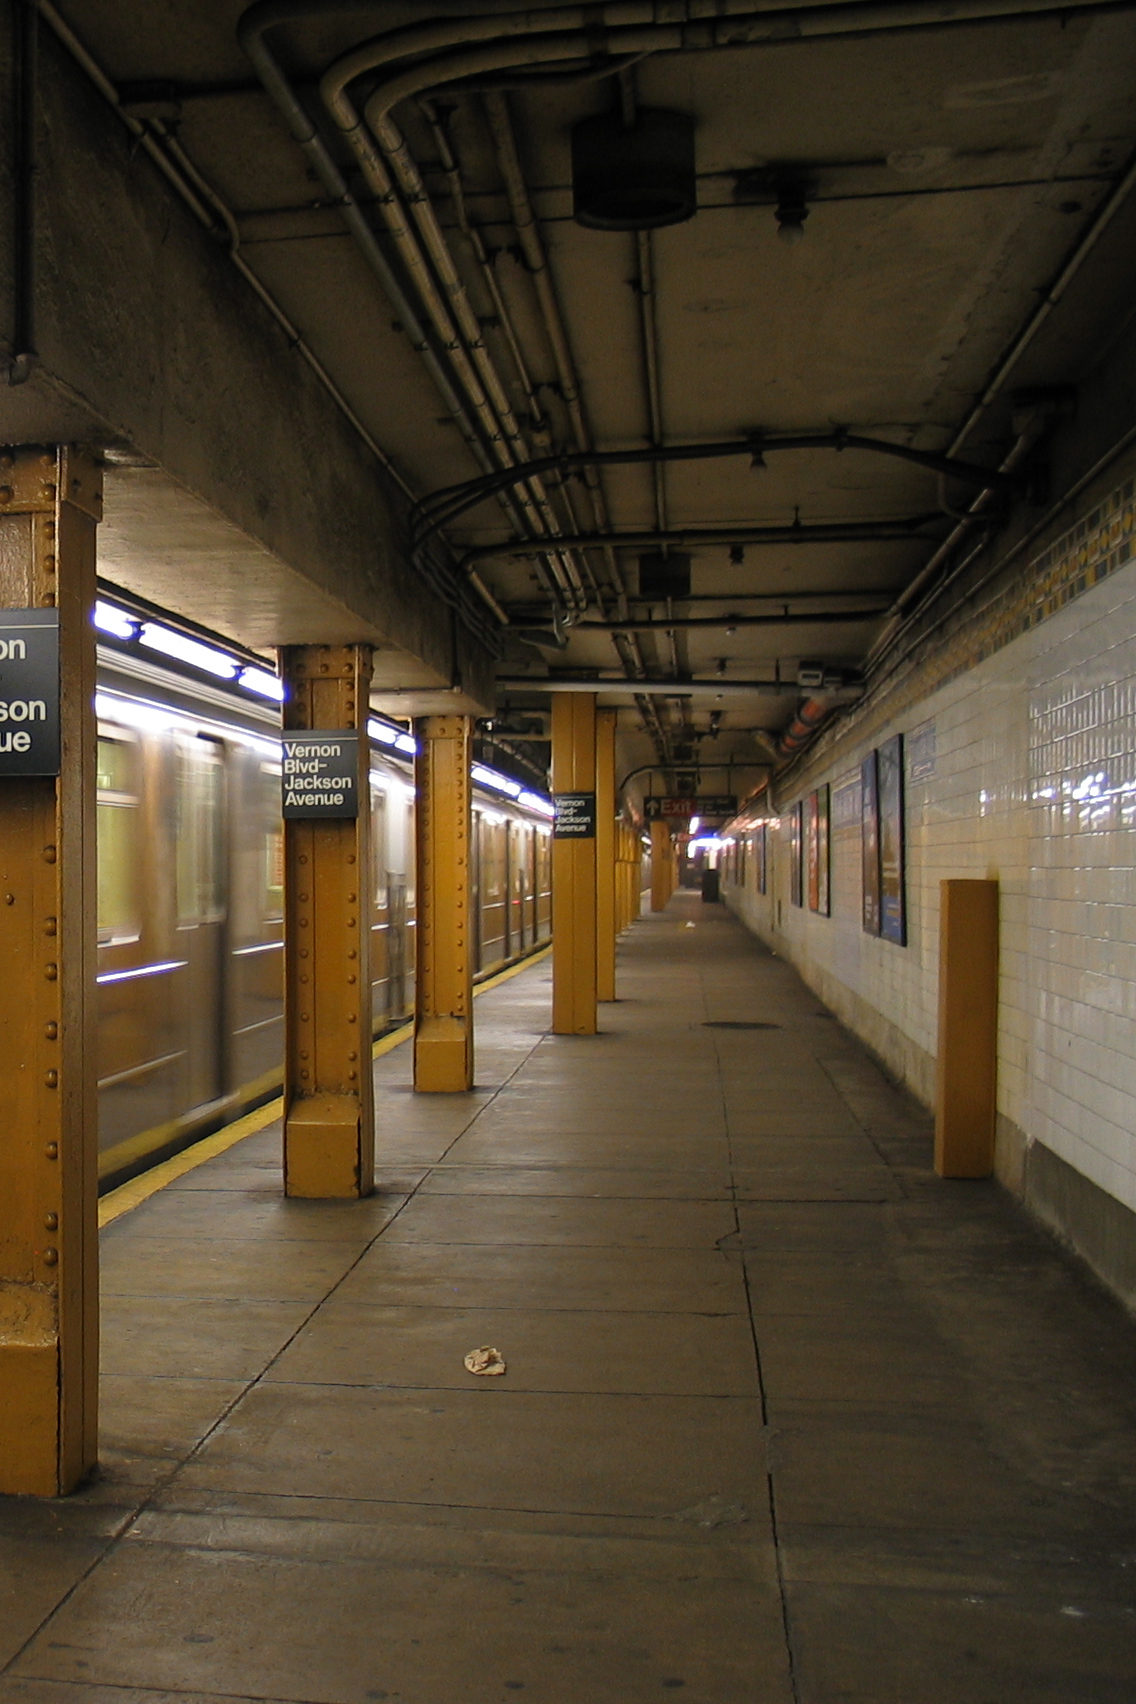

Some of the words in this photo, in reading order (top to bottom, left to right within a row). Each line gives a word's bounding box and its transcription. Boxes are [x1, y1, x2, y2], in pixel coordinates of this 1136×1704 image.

[284, 743, 341, 758] Vernon
[284, 759, 328, 774] Blvd-
[284, 775, 352, 790] Jackson
[285, 791, 344, 806] Avenue
[661, 798, 691, 814] Exit
